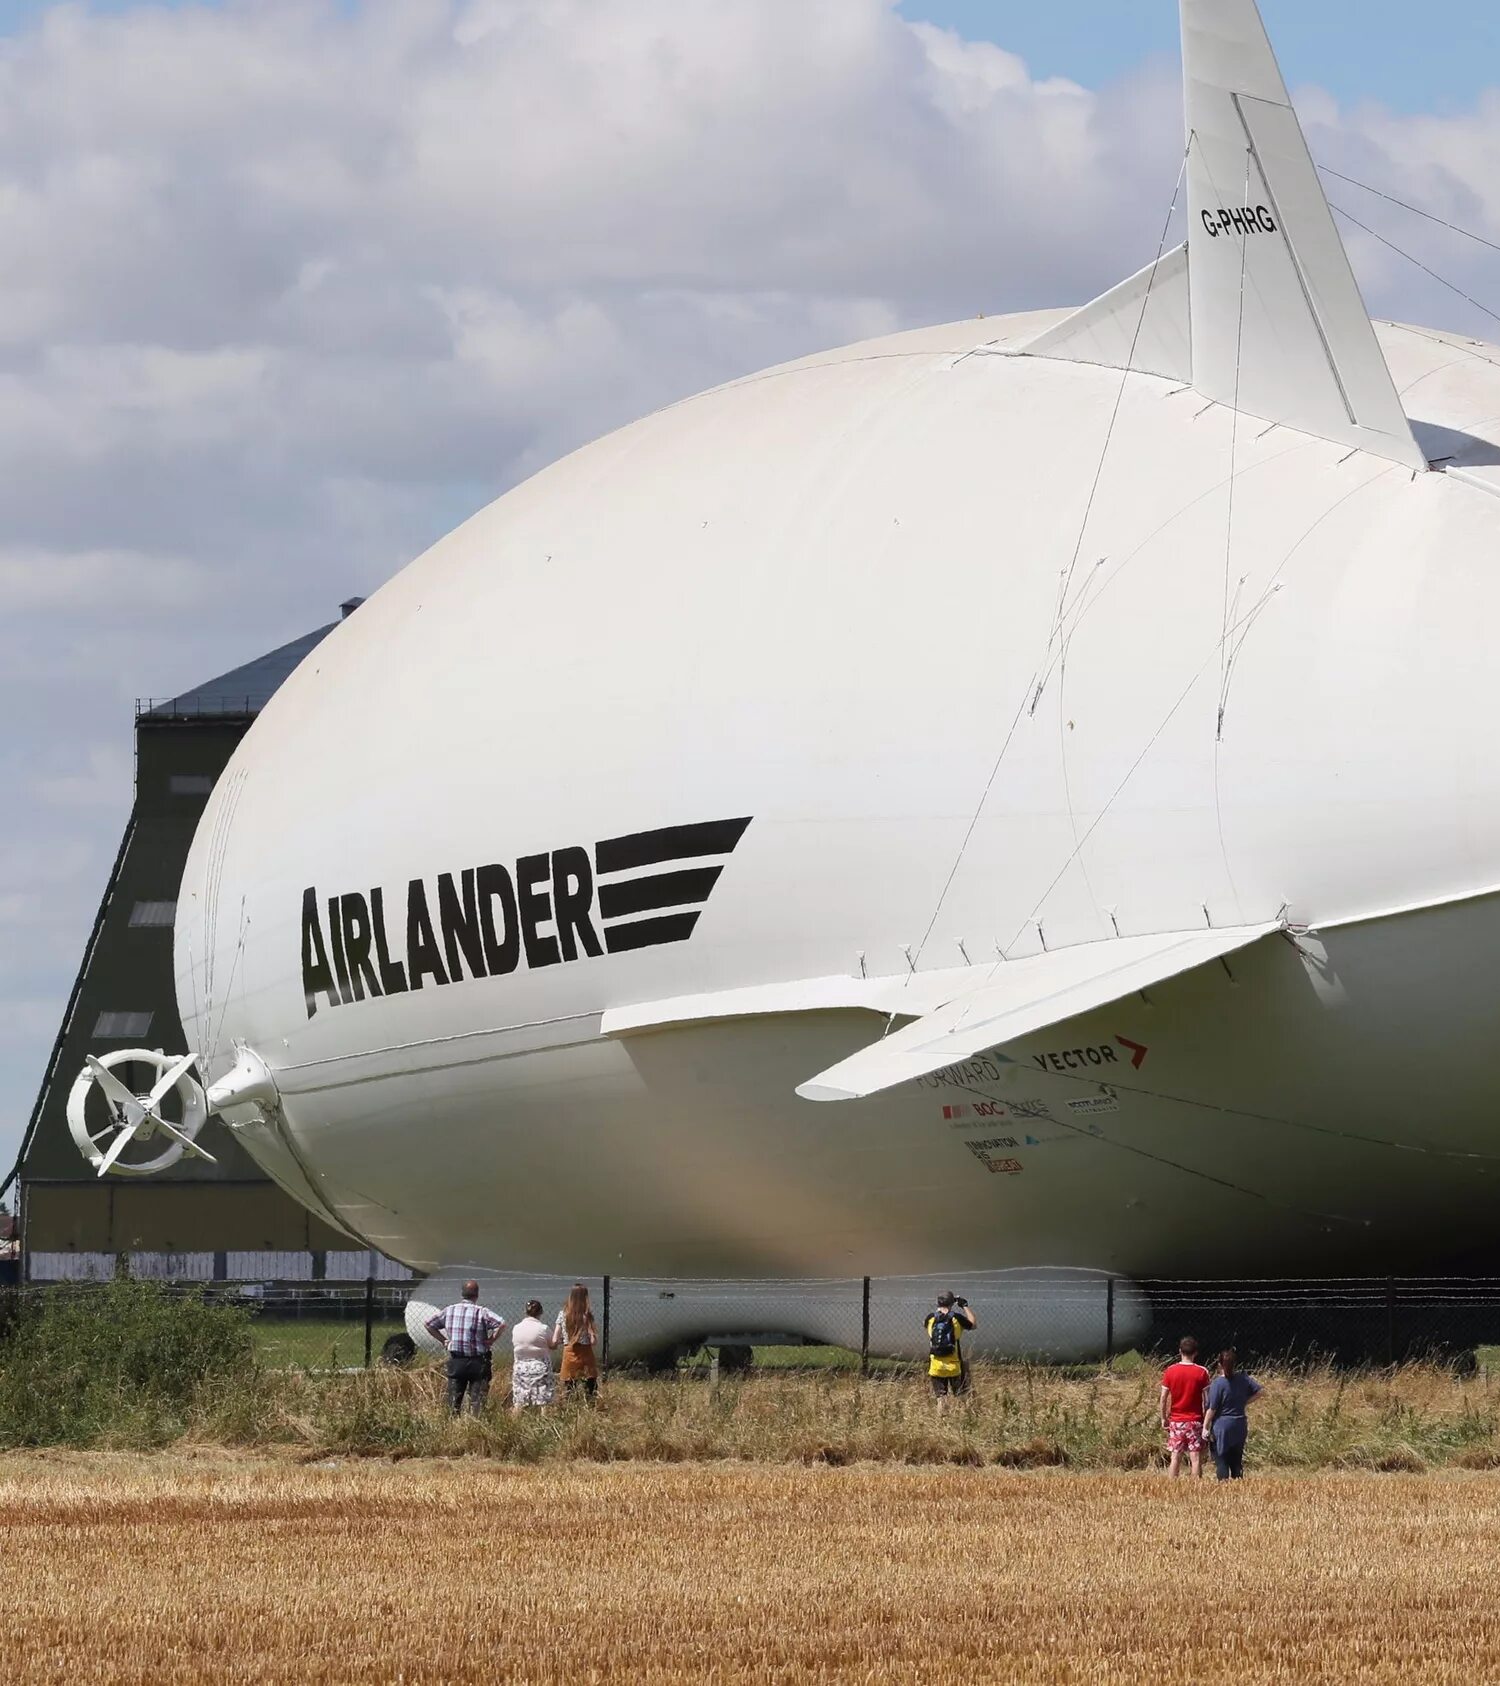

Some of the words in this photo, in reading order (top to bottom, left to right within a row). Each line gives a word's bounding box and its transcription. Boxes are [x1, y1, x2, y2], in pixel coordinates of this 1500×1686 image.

[1201, 205, 1278, 238] G-PHRG
[302, 846, 606, 1021] AIRLANDER
[1032, 1045, 1119, 1072] VECTOR
[972, 1101, 1005, 1117] BOC
